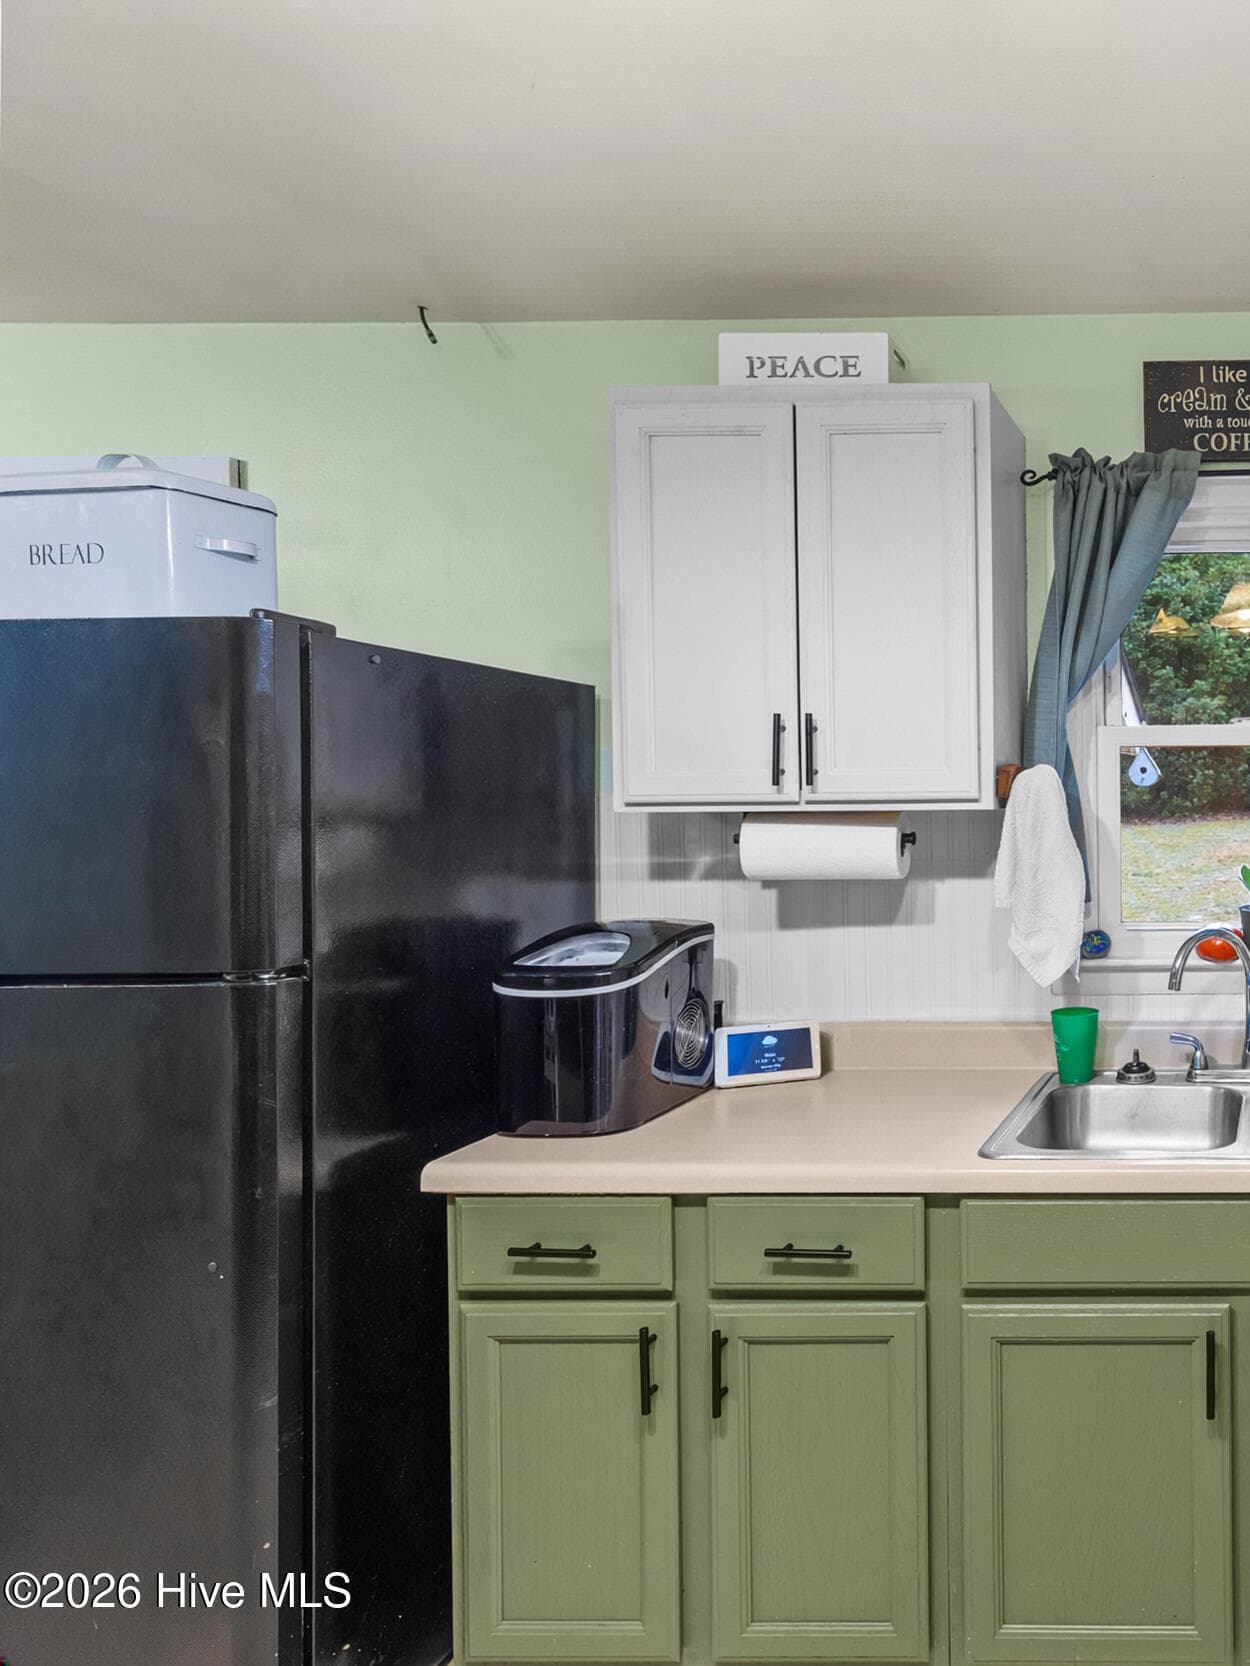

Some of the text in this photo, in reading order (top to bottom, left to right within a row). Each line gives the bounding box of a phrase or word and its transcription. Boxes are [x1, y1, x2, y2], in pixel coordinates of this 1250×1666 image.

[745, 355, 861, 378] PEACE
[1199, 366, 1205, 383] I
[1212, 366, 1247, 383] like
[1157, 387, 1228, 413] cream
[1184, 416, 1212, 428] with
[1216, 419, 1224, 428] a
[29, 542, 104, 565] BREAD
